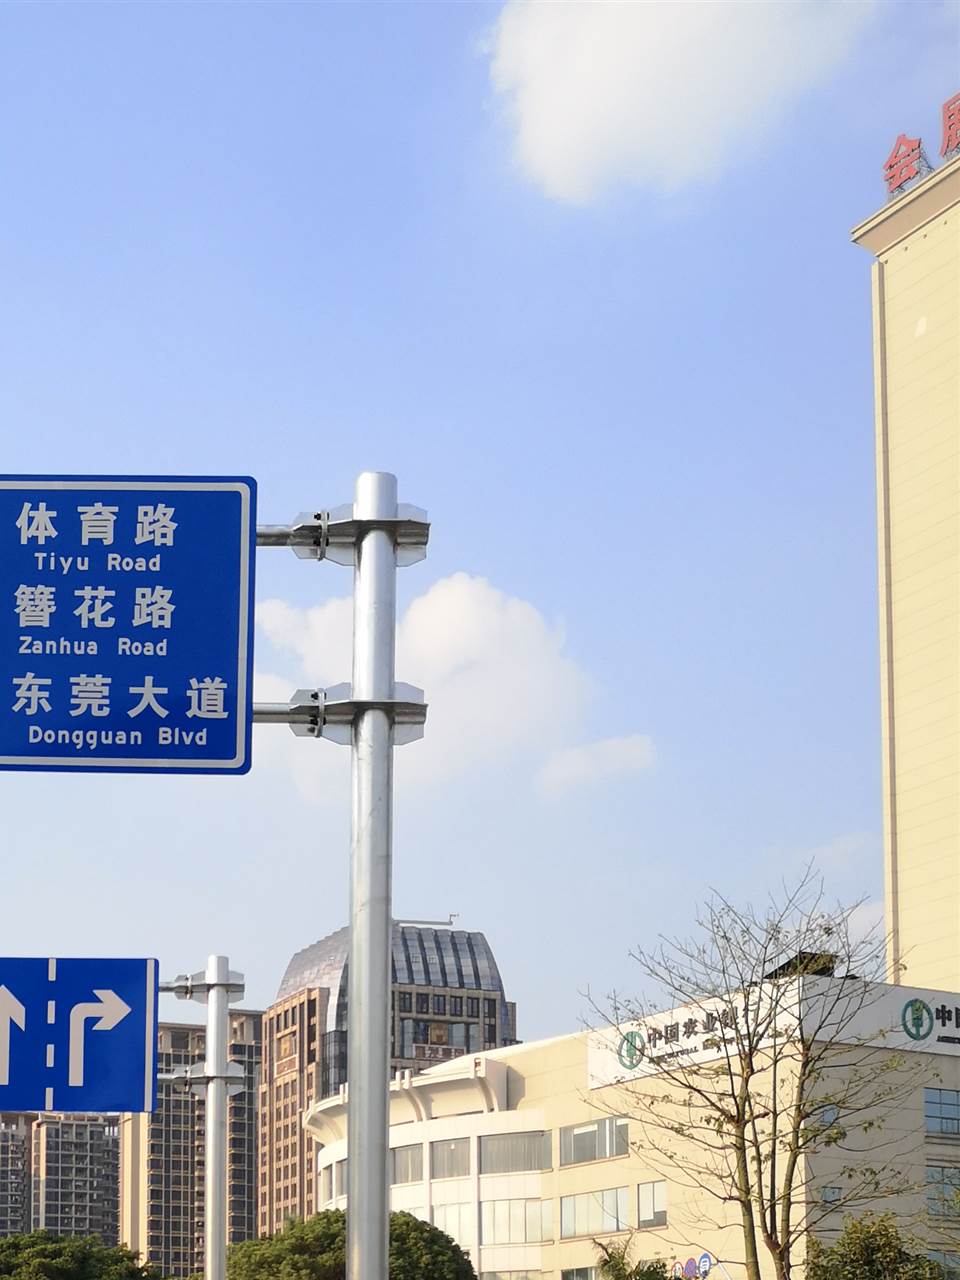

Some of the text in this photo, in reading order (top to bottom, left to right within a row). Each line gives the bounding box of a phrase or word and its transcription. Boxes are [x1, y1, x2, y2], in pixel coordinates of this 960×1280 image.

[15, 502, 179, 547] 体育路
[34, 552, 161, 575] Tiyu Road
[14, 584, 176, 629] 簪花路
[18, 636, 168, 656] Zanhua Road
[11, 671, 229, 719] 东莞大道
[28, 725, 207, 750] Dongguan Blvd
